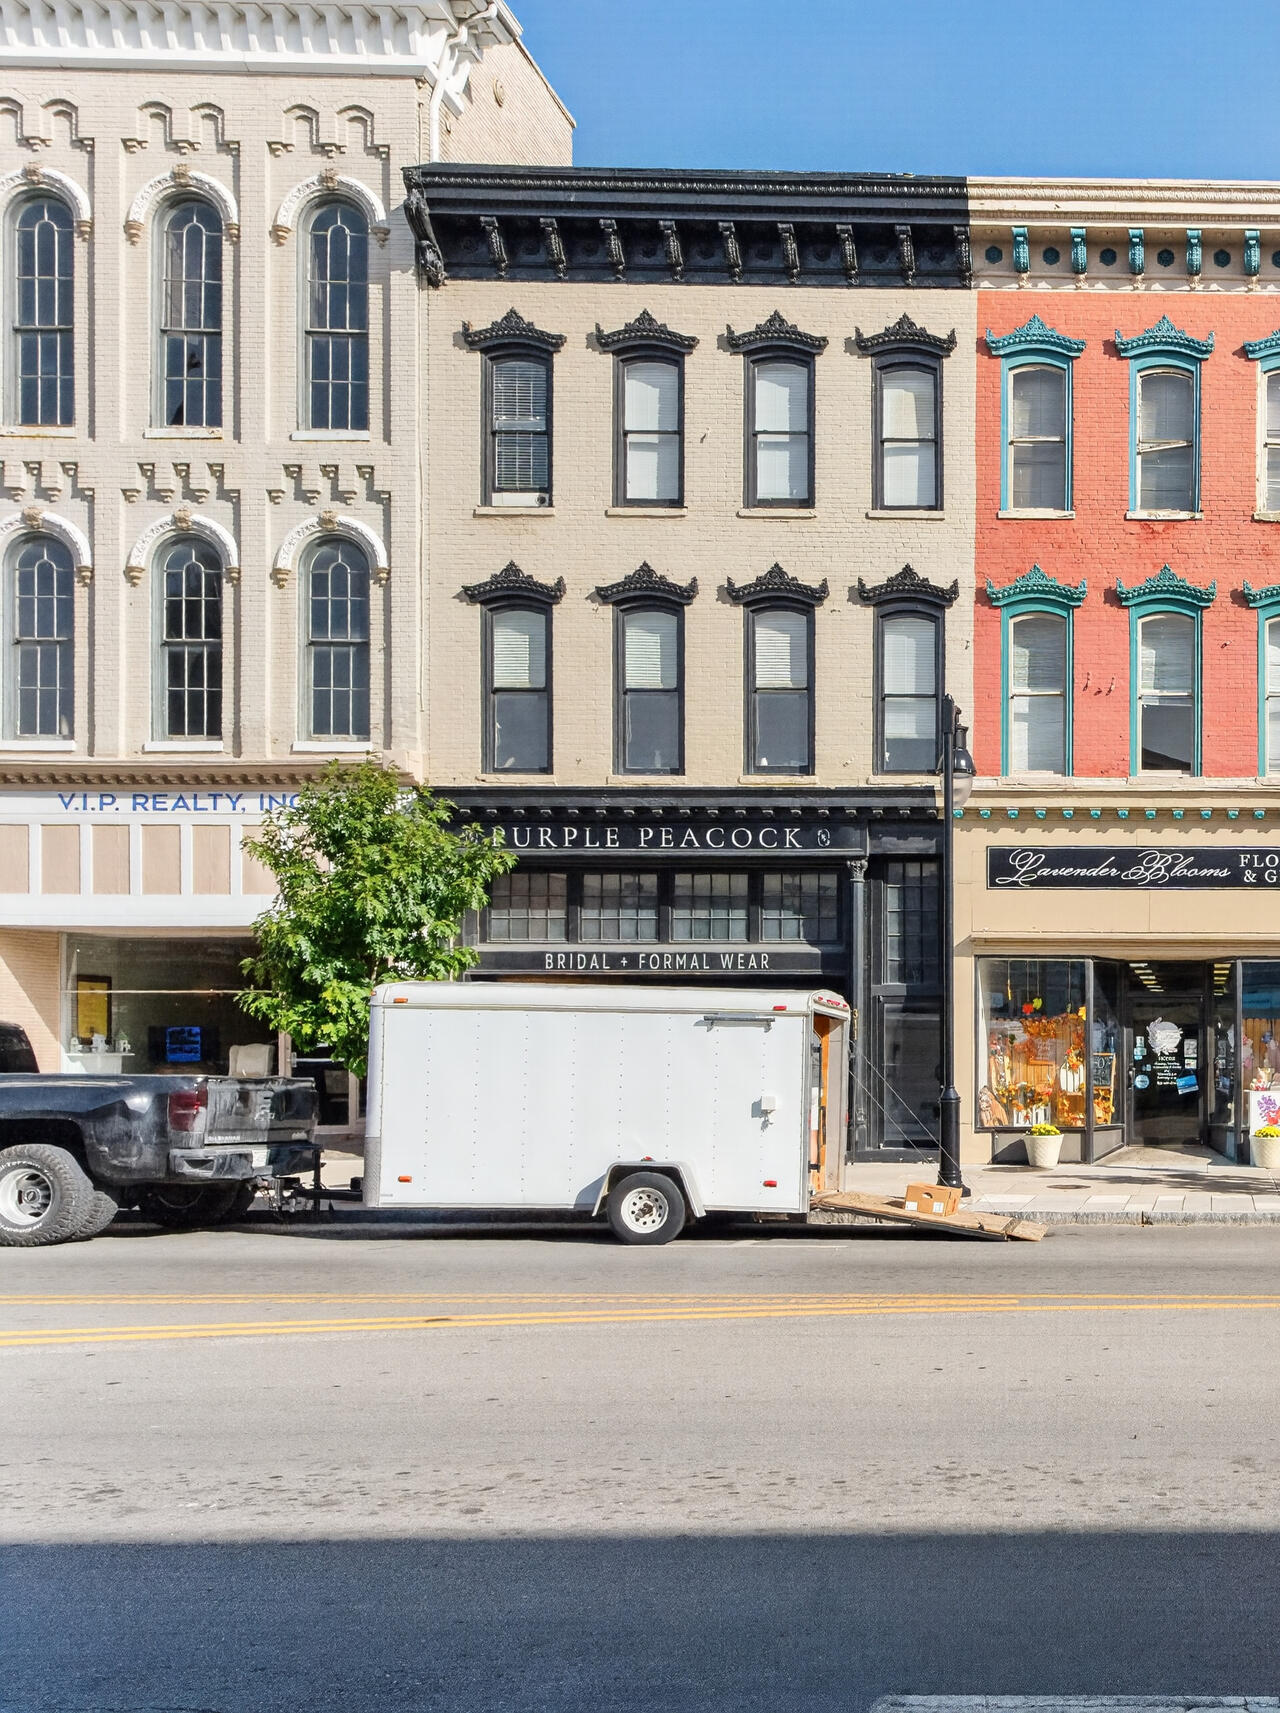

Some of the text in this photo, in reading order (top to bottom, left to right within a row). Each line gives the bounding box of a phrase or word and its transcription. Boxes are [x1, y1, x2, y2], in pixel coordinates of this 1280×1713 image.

[57, 793, 120, 811] V.I.P.
[131, 793, 246, 814] REALTY,
[491, 826, 803, 849] PURPLE PEACOCK
[995, 848, 1231, 887] Lavender Blooms
[1243, 869, 1257, 883] &
[545, 953, 610, 970] BRIDAL
[638, 953, 711, 970] FORMAL
[720, 953, 770, 970] WEAR
